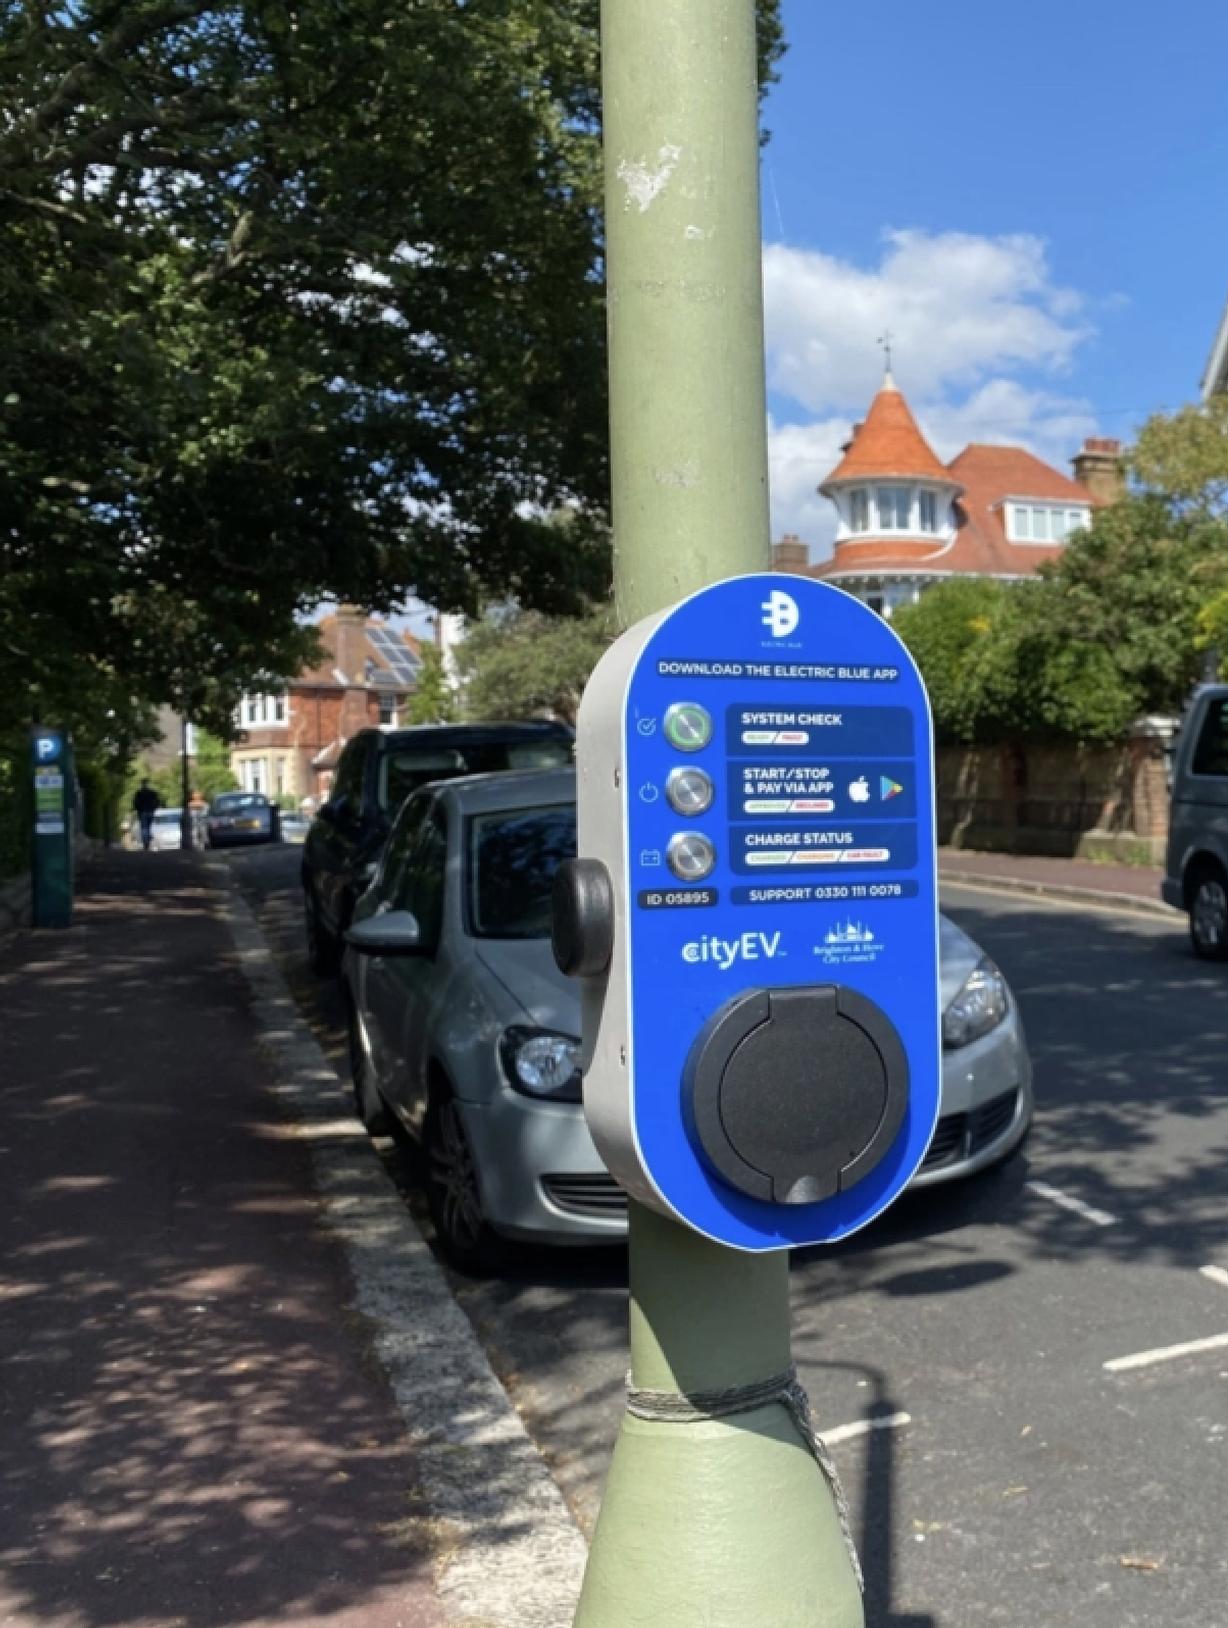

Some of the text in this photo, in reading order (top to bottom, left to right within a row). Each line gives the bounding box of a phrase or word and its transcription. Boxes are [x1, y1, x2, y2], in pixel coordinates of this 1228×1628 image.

[658, 661, 897, 681] DOWNLOAD THE ELECTRIC BLUE APP
[741, 711, 842, 726] SYSTEM CHECK
[38, 738, 56, 760] P
[742, 767, 830, 781] START/STOP
[743, 781, 834, 794] & PAY VIA APP
[744, 832, 854, 846] CHARGE STATUS
[646, 893, 663, 906] ID
[749, 883, 902, 901] SUPPORT 0330 111 0078
[681, 930, 781, 971] cityEV
